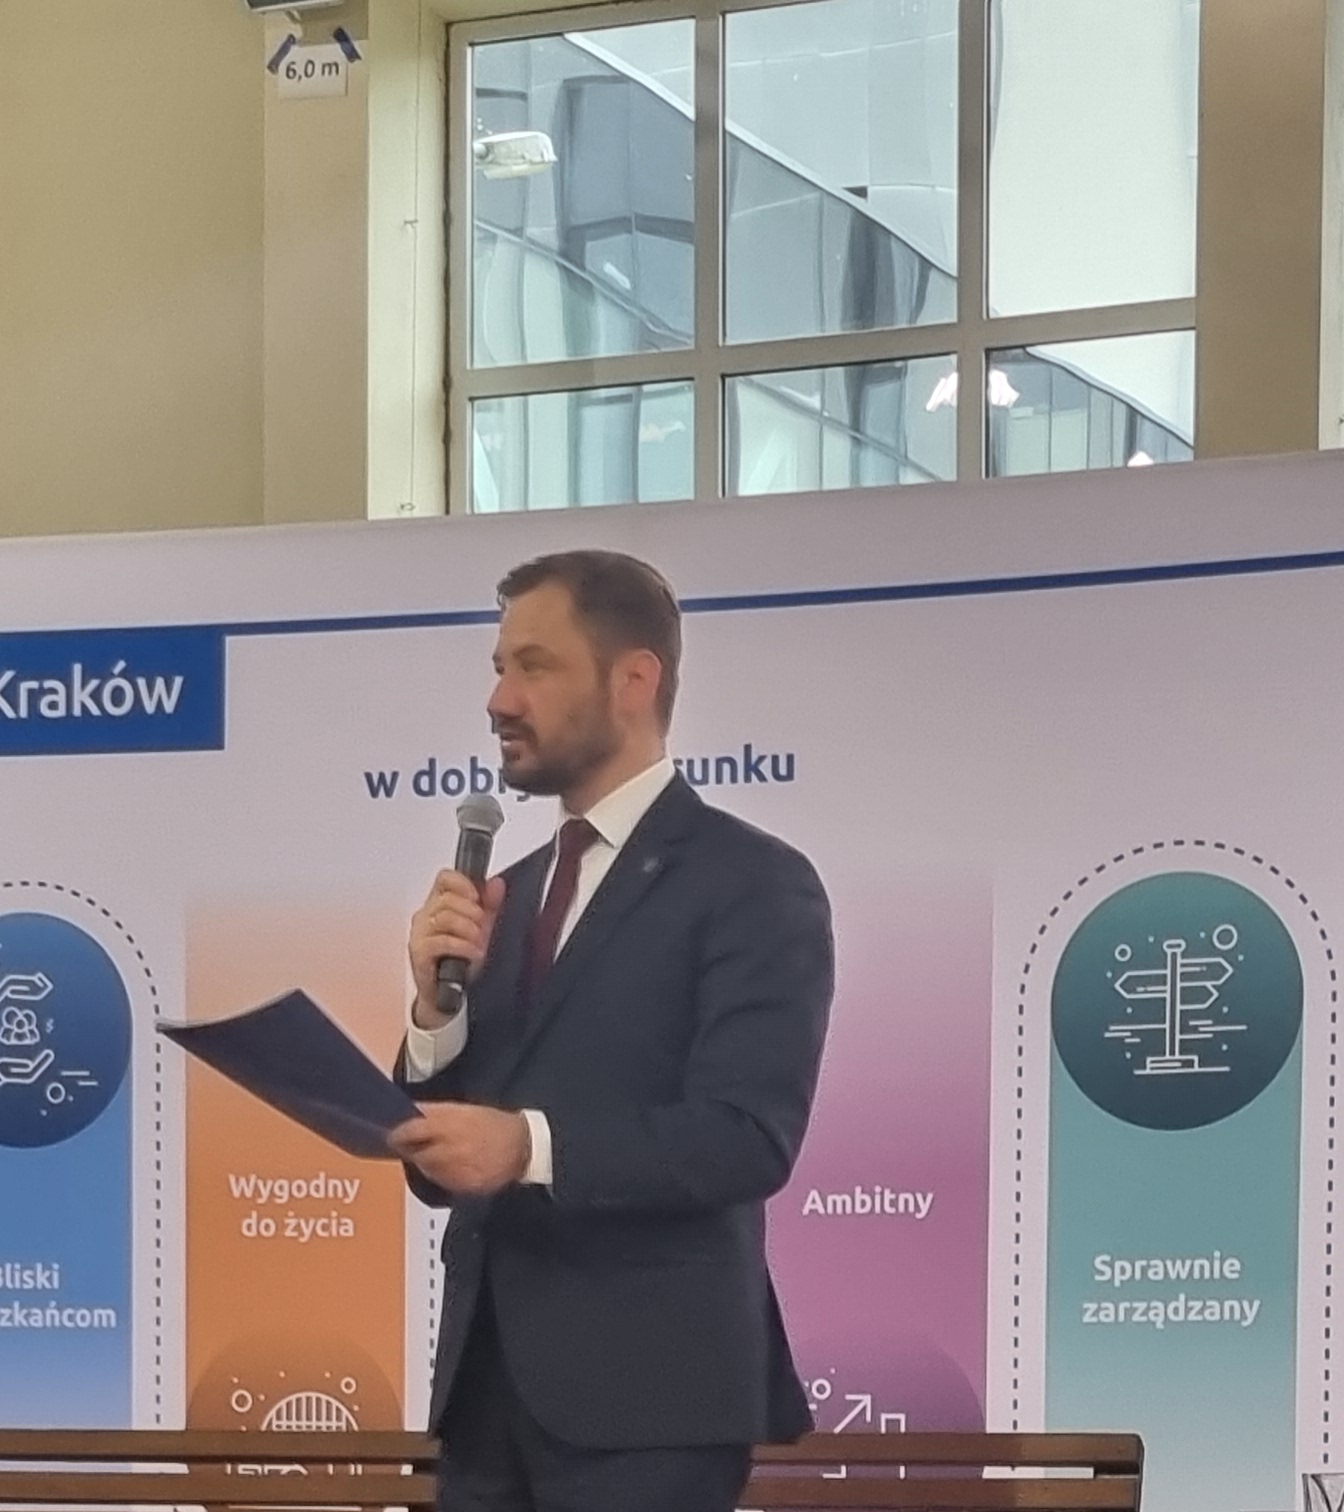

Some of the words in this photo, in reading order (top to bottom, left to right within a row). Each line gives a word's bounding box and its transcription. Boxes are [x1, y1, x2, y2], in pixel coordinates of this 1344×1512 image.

[285, 59, 316, 82] 6,0
[321, 61, 340, 77] m
[364, 770, 400, 799] w
[228, 1172, 361, 1204] Wygodny
[802, 1185, 934, 1220] Ambitny
[241, 1211, 276, 1238] do
[283, 1211, 355, 1243] życia
[1093, 1251, 1242, 1287] Sprawnie
[1081, 1293, 1262, 1329] zarządzany
